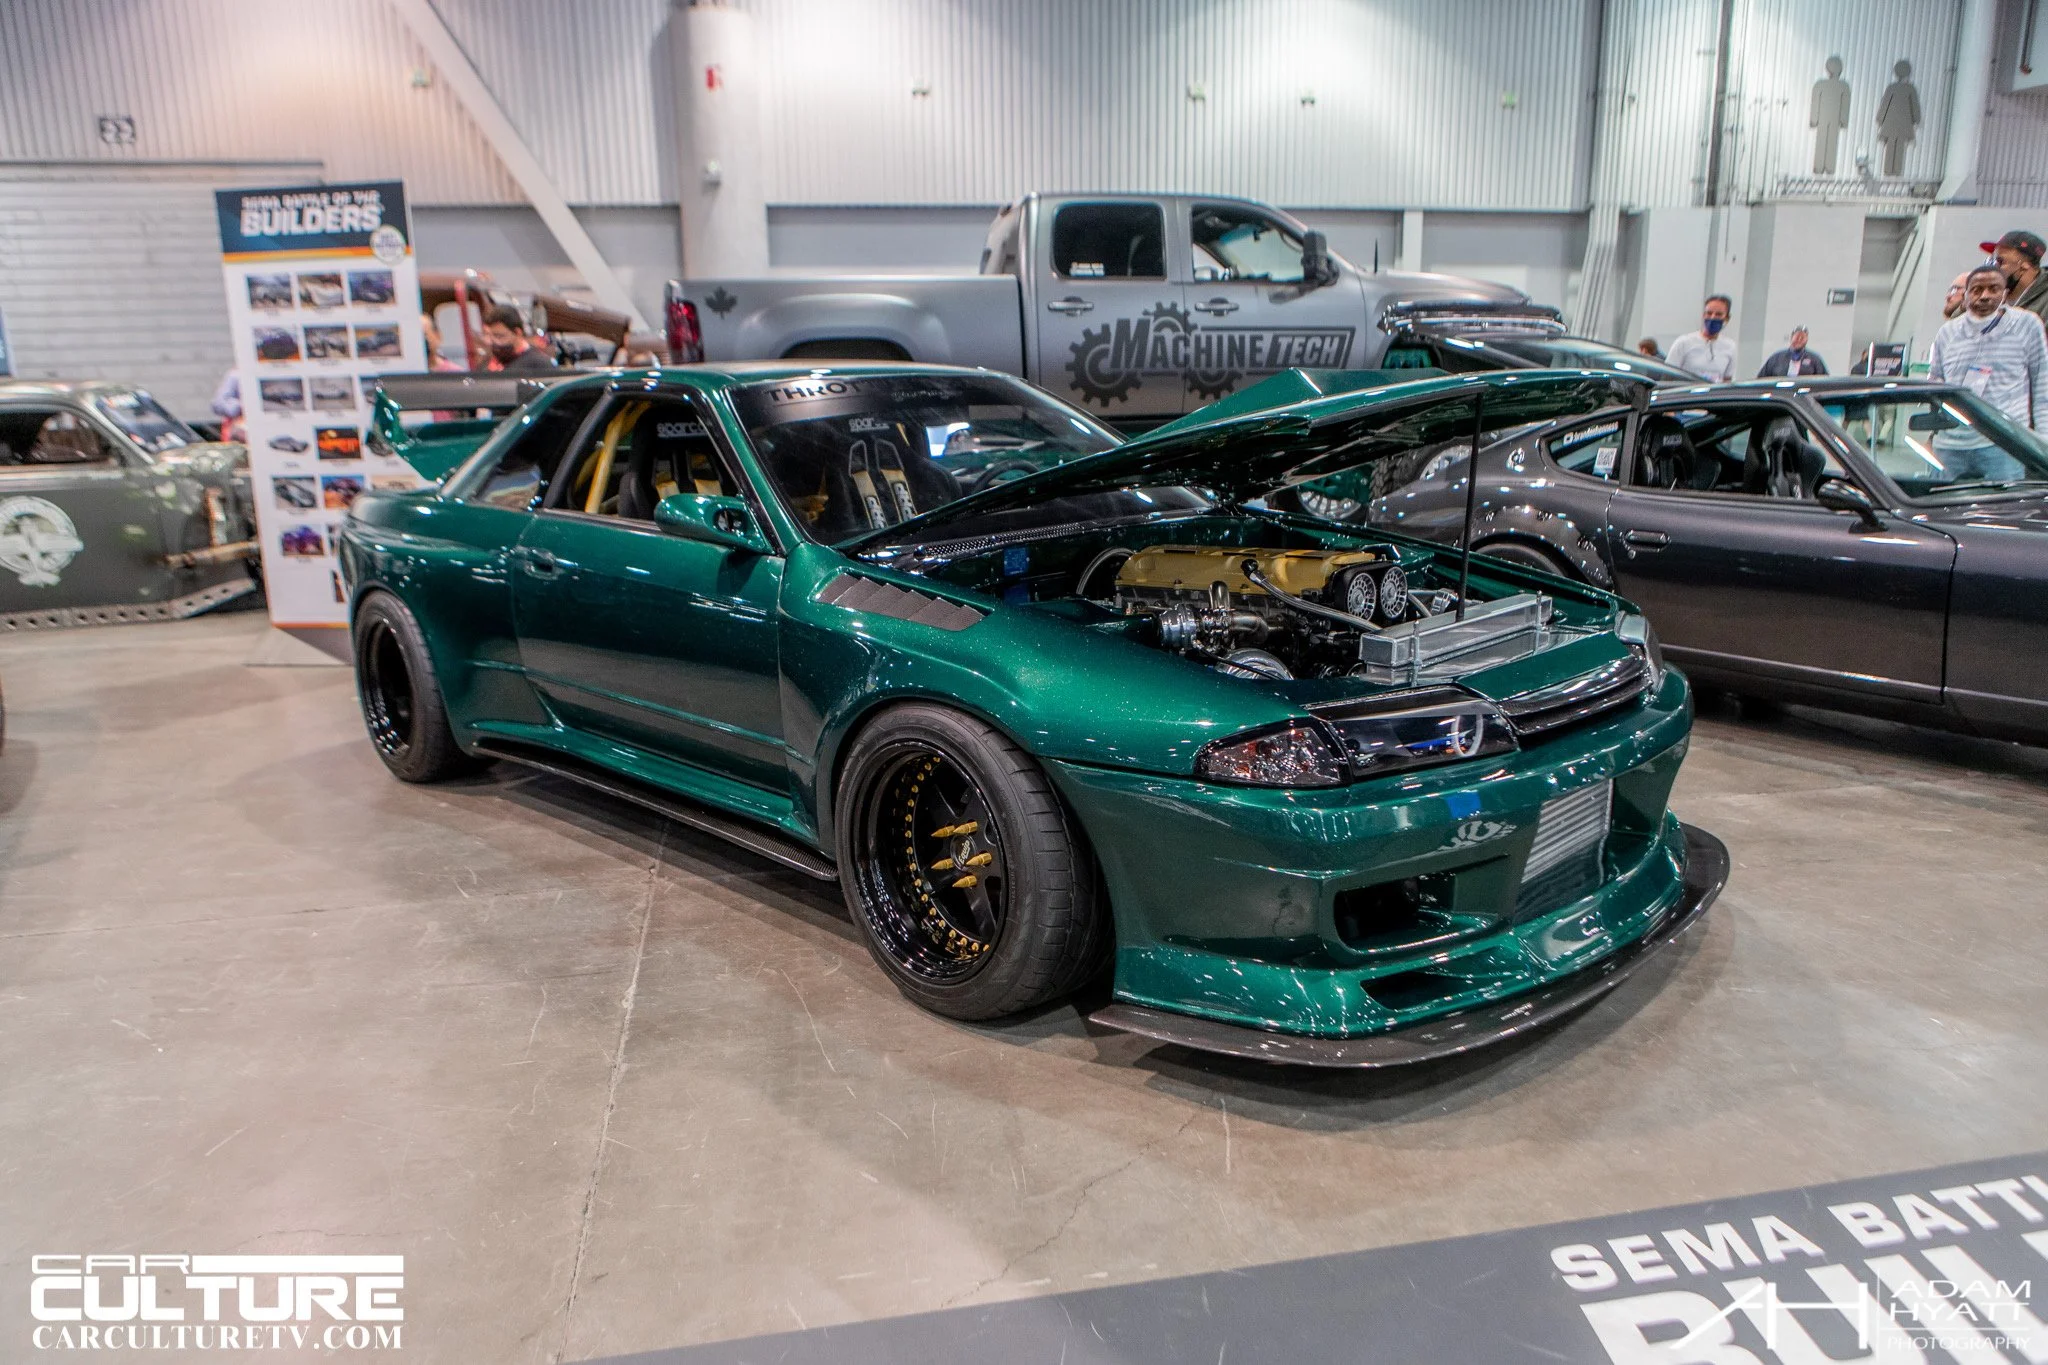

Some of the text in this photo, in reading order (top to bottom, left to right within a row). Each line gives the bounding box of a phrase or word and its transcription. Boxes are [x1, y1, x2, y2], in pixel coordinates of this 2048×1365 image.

[240, 203, 382, 237] BUILDERS
[1276, 336, 1341, 367] TECH
[1550, 1215, 1825, 1292] SEMA
